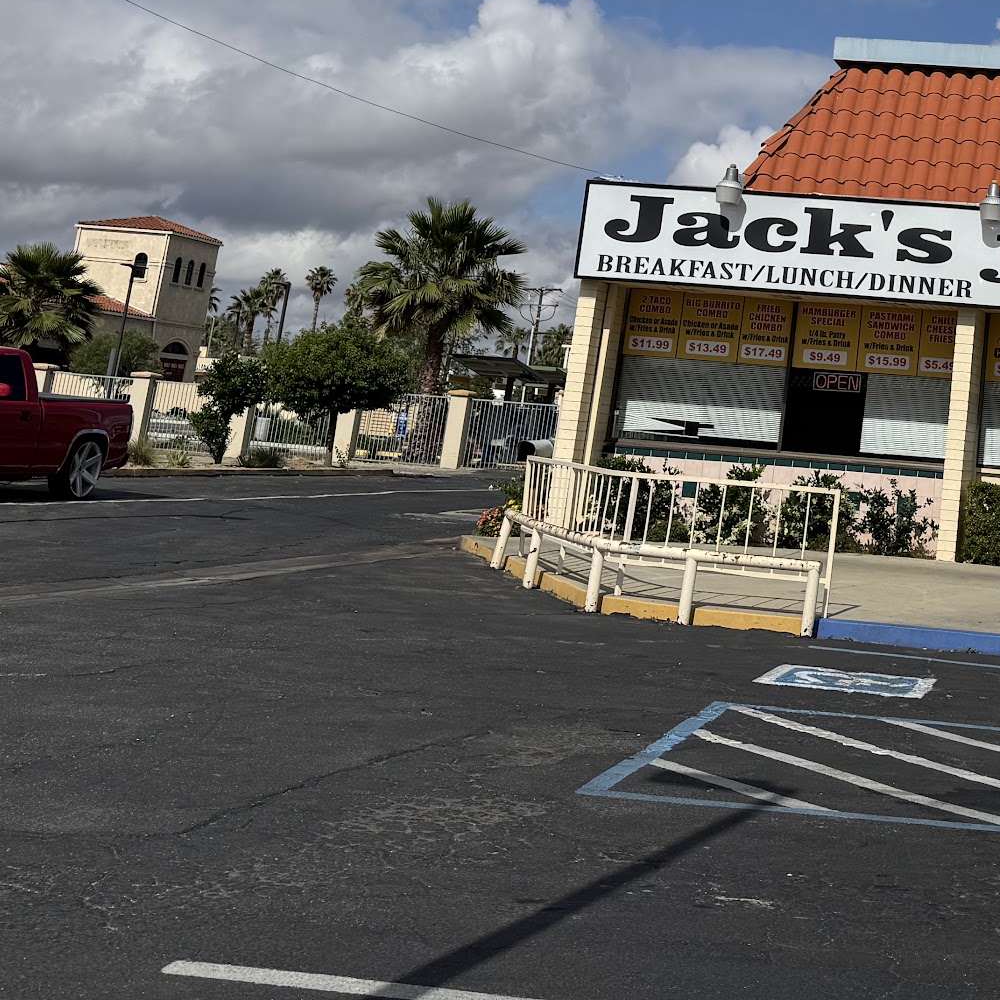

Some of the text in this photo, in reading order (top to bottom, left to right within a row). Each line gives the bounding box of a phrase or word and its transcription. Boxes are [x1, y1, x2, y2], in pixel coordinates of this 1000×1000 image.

[604, 195, 953, 264] Jack's
[596, 254, 972, 299] BREAKFAST/LUNCH/DINNER
[650, 296, 671, 305] TACO
[686, 299, 740, 310] BIG BURRITO
[640, 305, 671, 314] COMBO
[697, 309, 727, 318] COMBO
[757, 304, 780, 313] FRIED
[803, 307, 856, 318] HAMBURGER
[630, 316, 652, 324] Chicken
[749, 313, 786, 323] CHICKEN
[811, 317, 845, 326] SPECIAL
[870, 312, 914, 322] PASTRAMI
[932, 316, 954, 325] CHILI
[683, 320, 709, 328] Chicken
[751, 322, 782, 331] COMBO
[867, 321, 914, 331] SANDWICH
[926, 325, 954, 334] CHEES
[829, 331, 846, 339] Patty
[875, 331, 906, 340] COMBO
[930, 335, 953, 343] FRIES
[632, 338, 669, 349] $11.99
[689, 342, 726, 353] $13.49
[864, 342, 889, 350] w/Fries
[896, 344, 914, 352] Drink
[745, 347, 782, 358] $17.49
[810, 351, 840, 362] $9.49
[869, 356, 906, 366] $15.99
[815, 375, 859, 391] OPEN
